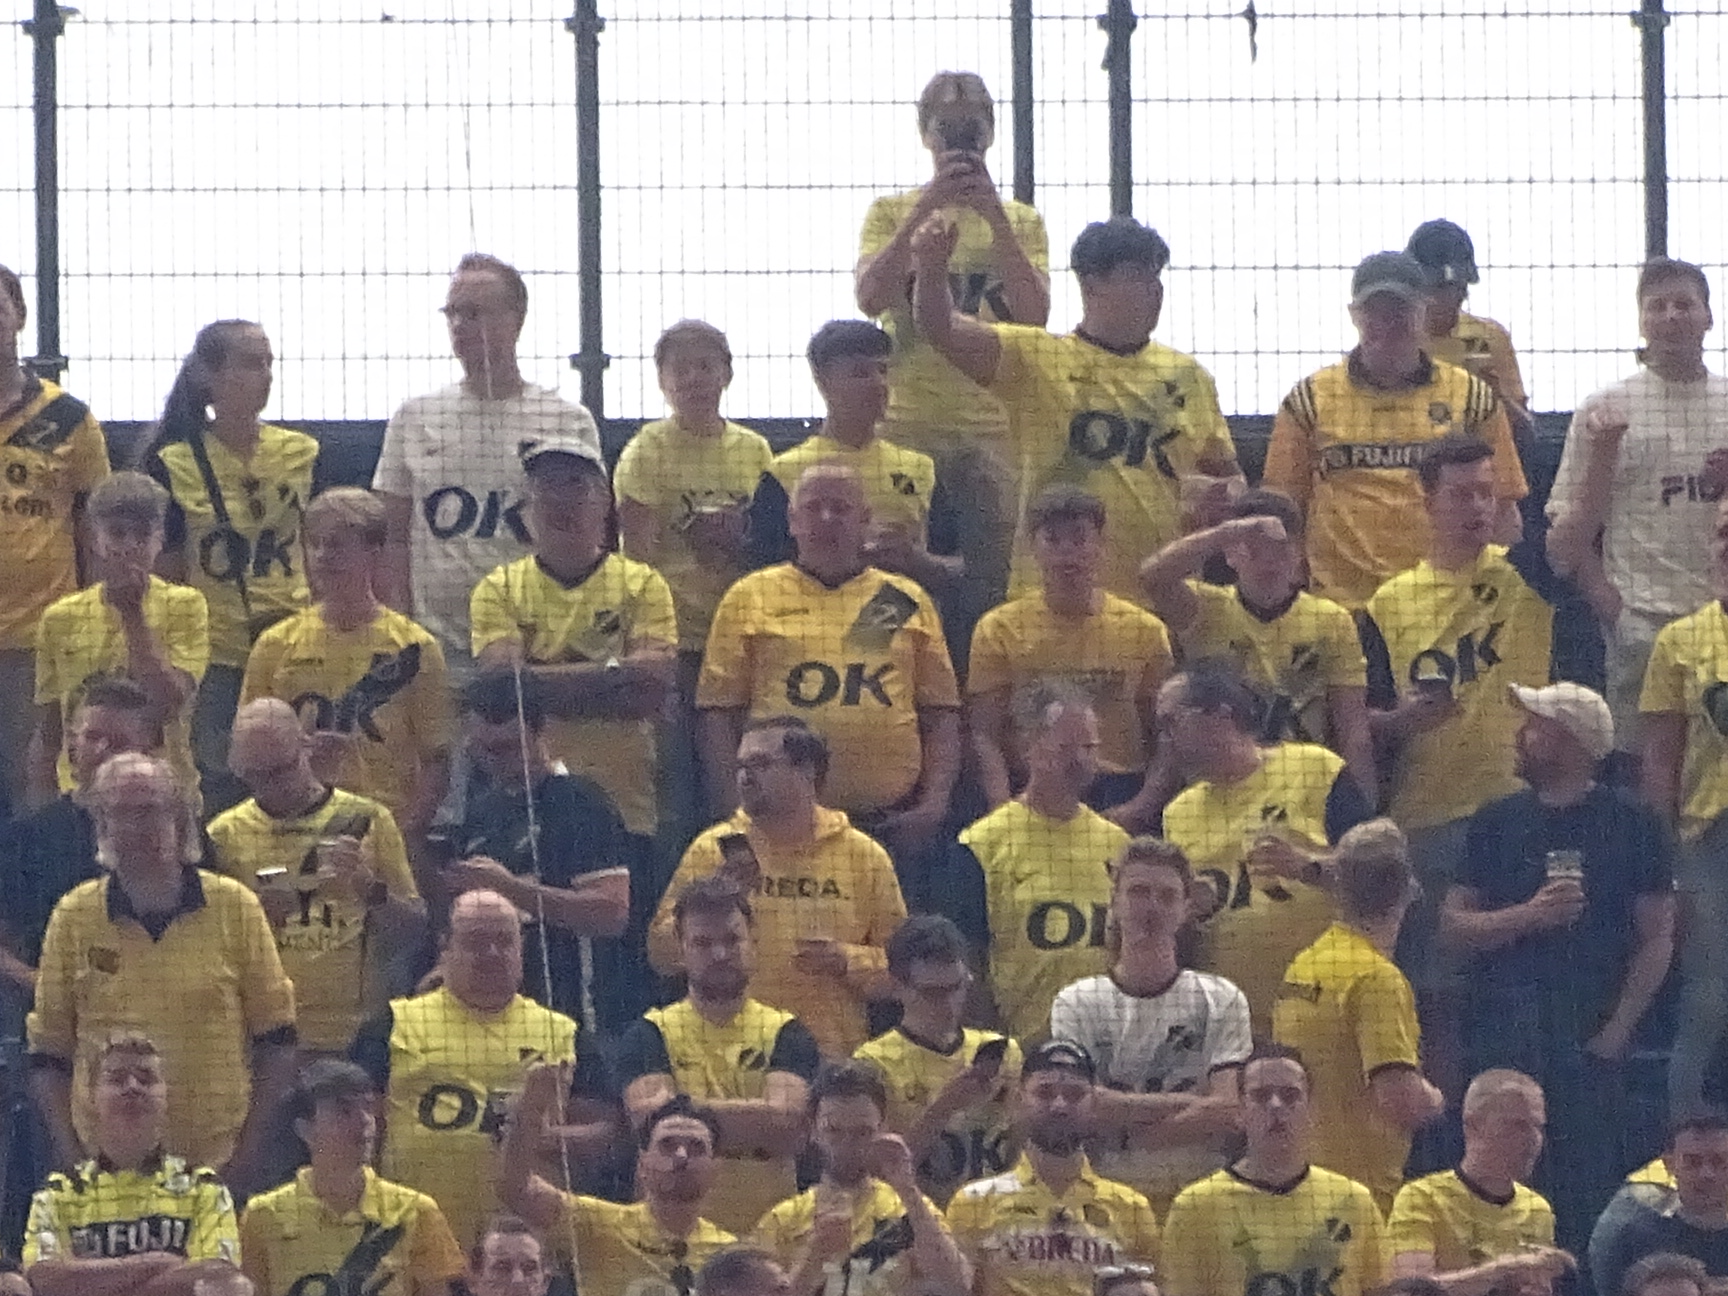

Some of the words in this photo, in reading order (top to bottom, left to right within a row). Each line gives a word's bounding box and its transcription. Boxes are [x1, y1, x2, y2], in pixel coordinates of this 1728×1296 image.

[1071, 409, 1182, 480] OK
[425, 484, 530, 544] OK
[198, 527, 295, 581] OK
[1410, 620, 1502, 684] OK
[786, 661, 893, 708] OK
